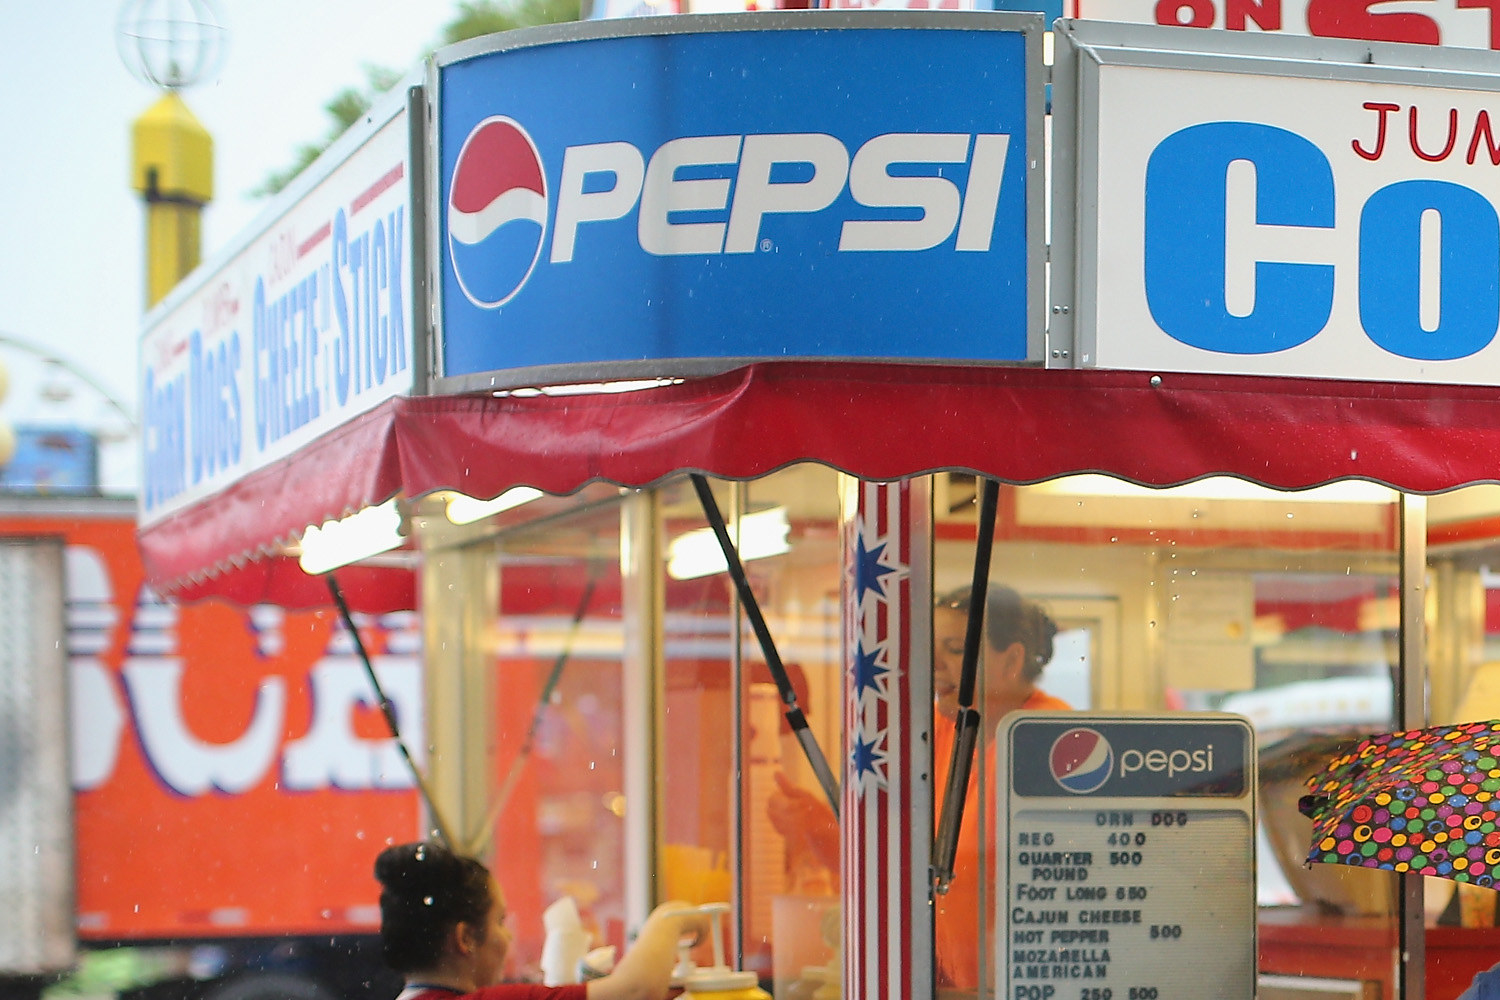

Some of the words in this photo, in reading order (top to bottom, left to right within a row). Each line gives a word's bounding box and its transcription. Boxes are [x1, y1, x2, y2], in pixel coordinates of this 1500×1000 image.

[549, 132, 1011, 264] PEPSI
[331, 205, 407, 408] STICK
[1120, 744, 1213, 778] pepsi
[1151, 812, 1187, 827] DOG
[1018, 832, 1055, 846] REG
[1107, 832, 1147, 846] 400
[1018, 852, 1093, 866] QUARTER
[1109, 852, 1143, 866] 500
[1031, 867, 1089, 881] POUND
[1017, 883, 1057, 900] FOOT
[1066, 886, 1107, 901] LONG
[1011, 906, 1069, 924] CAJUN
[1078, 909, 1143, 924] CHEESE
[1013, 930, 1044, 944] HOT
[1050, 929, 1110, 944] PEPPER
[1150, 924, 1183, 939] 500
[1013, 949, 1111, 963] MOZARELLA
[1013, 964, 1107, 979] AMERICAN
[1128, 986, 1159, 1000] 500
